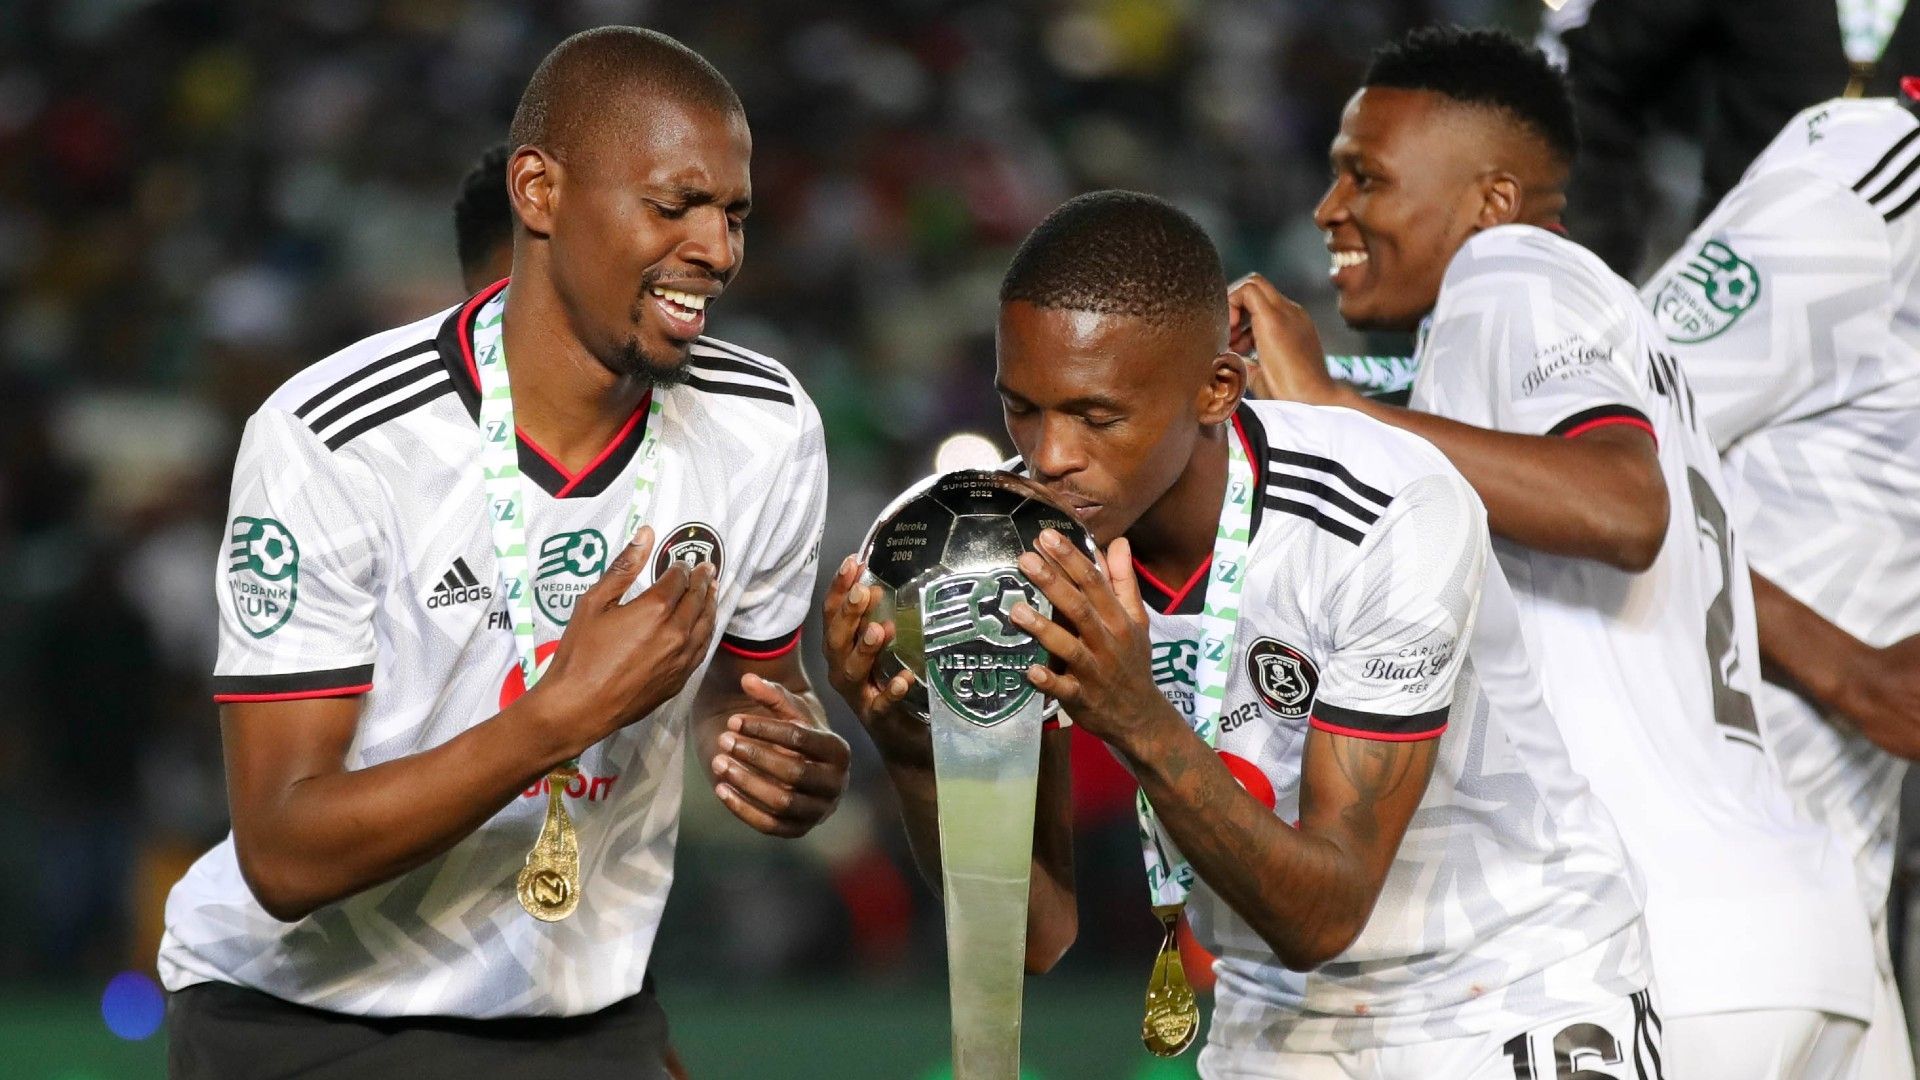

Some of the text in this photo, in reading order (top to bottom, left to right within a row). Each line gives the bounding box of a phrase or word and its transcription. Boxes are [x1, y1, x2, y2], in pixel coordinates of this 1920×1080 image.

[969, 490, 993, 498] 2022
[895, 521, 928, 532] Moroka
[886, 536, 928, 547] Swallows
[891, 550, 913, 562] 2009
[426, 585, 493, 610] adidas
[1361, 658, 1427, 680] Black
[952, 671, 1022, 698] CUP
[1219, 701, 1263, 733] 2023
